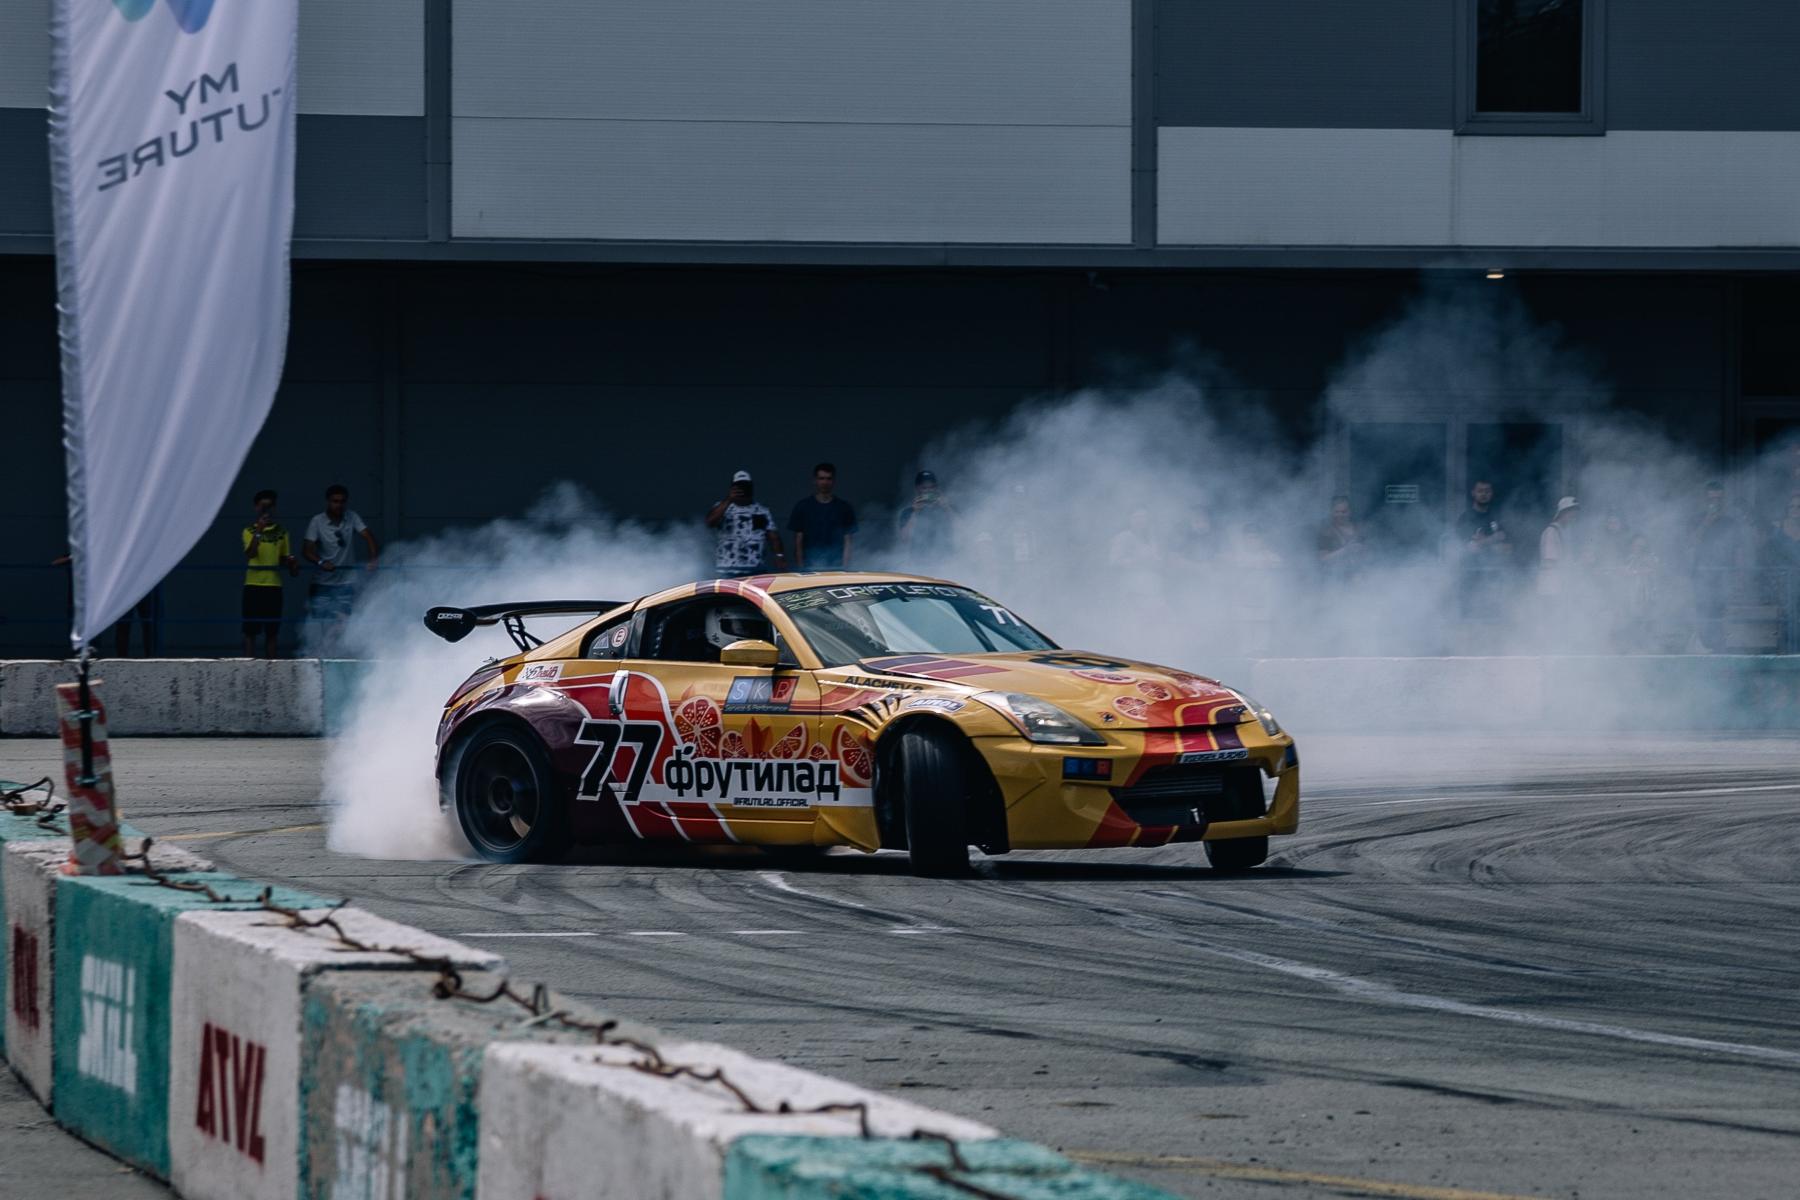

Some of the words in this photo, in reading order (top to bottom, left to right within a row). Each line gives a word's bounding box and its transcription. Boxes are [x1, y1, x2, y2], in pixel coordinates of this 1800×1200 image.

[827, 585, 895, 599] DRIFT
[897, 585, 958, 597] LETO
[979, 604, 1022, 627] 77
[574, 718, 664, 805] 77
